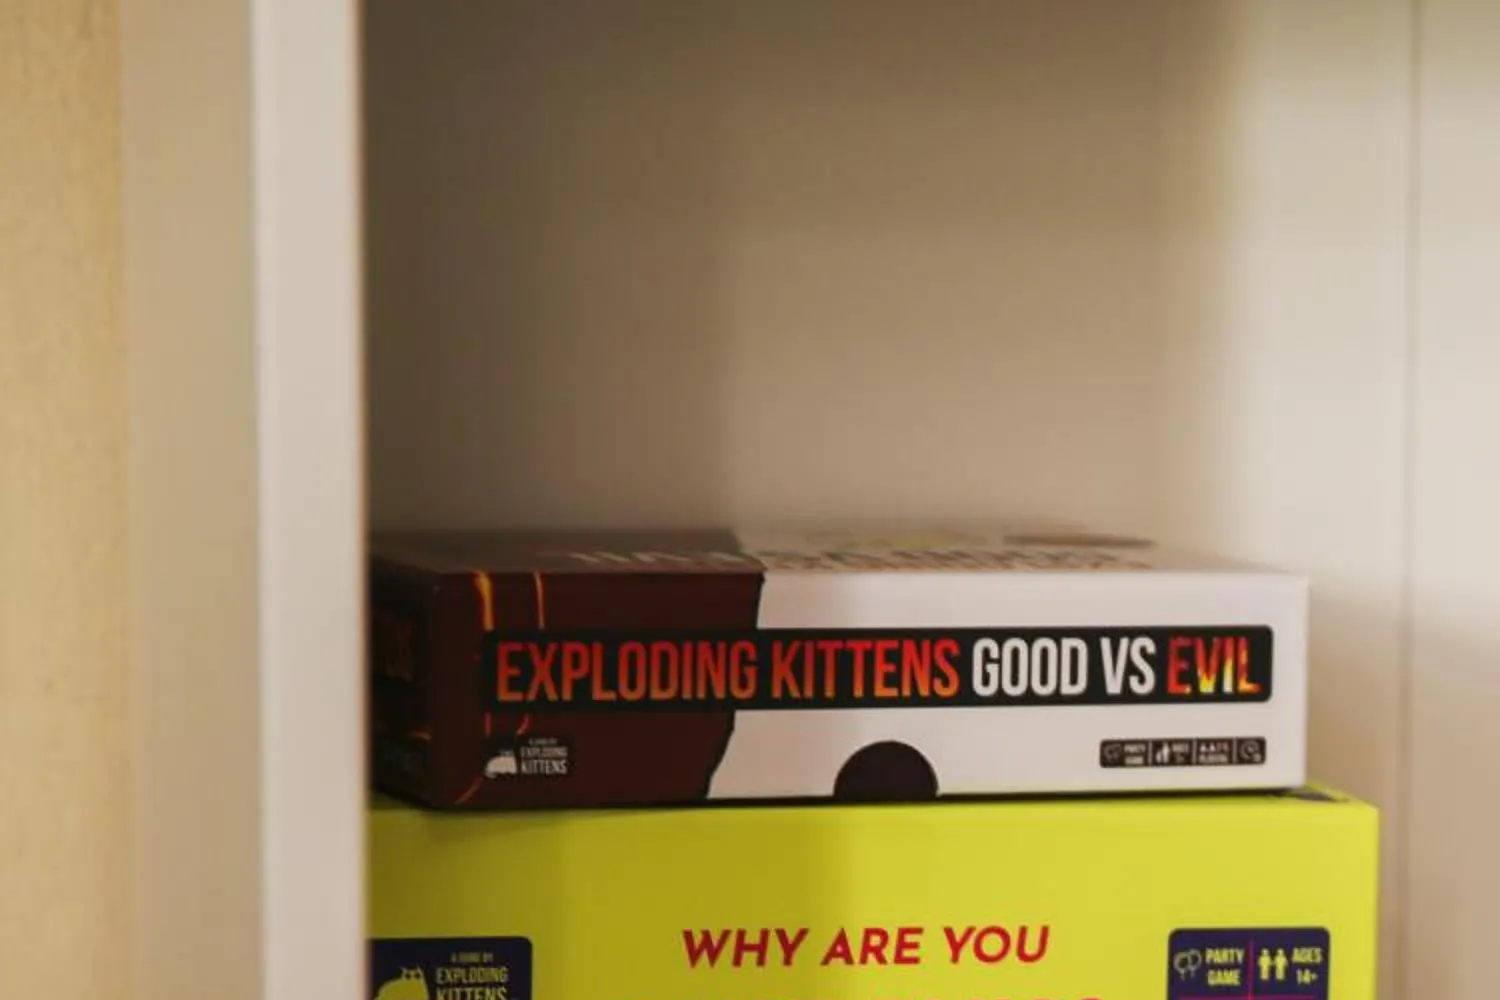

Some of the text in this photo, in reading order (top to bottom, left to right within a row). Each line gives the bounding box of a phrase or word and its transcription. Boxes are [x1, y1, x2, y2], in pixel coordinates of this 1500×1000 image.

[496, 635, 1262, 702] EXPLODING KITTENS GOOD VS EVIL
[682, 925, 1050, 968] WHY ARE YOU
[1205, 947, 1245, 964] PARTY
[1292, 946, 1322, 963] AGES
[435, 966, 509, 984] EXPLODING
[1207, 968, 1241, 986] GAME
